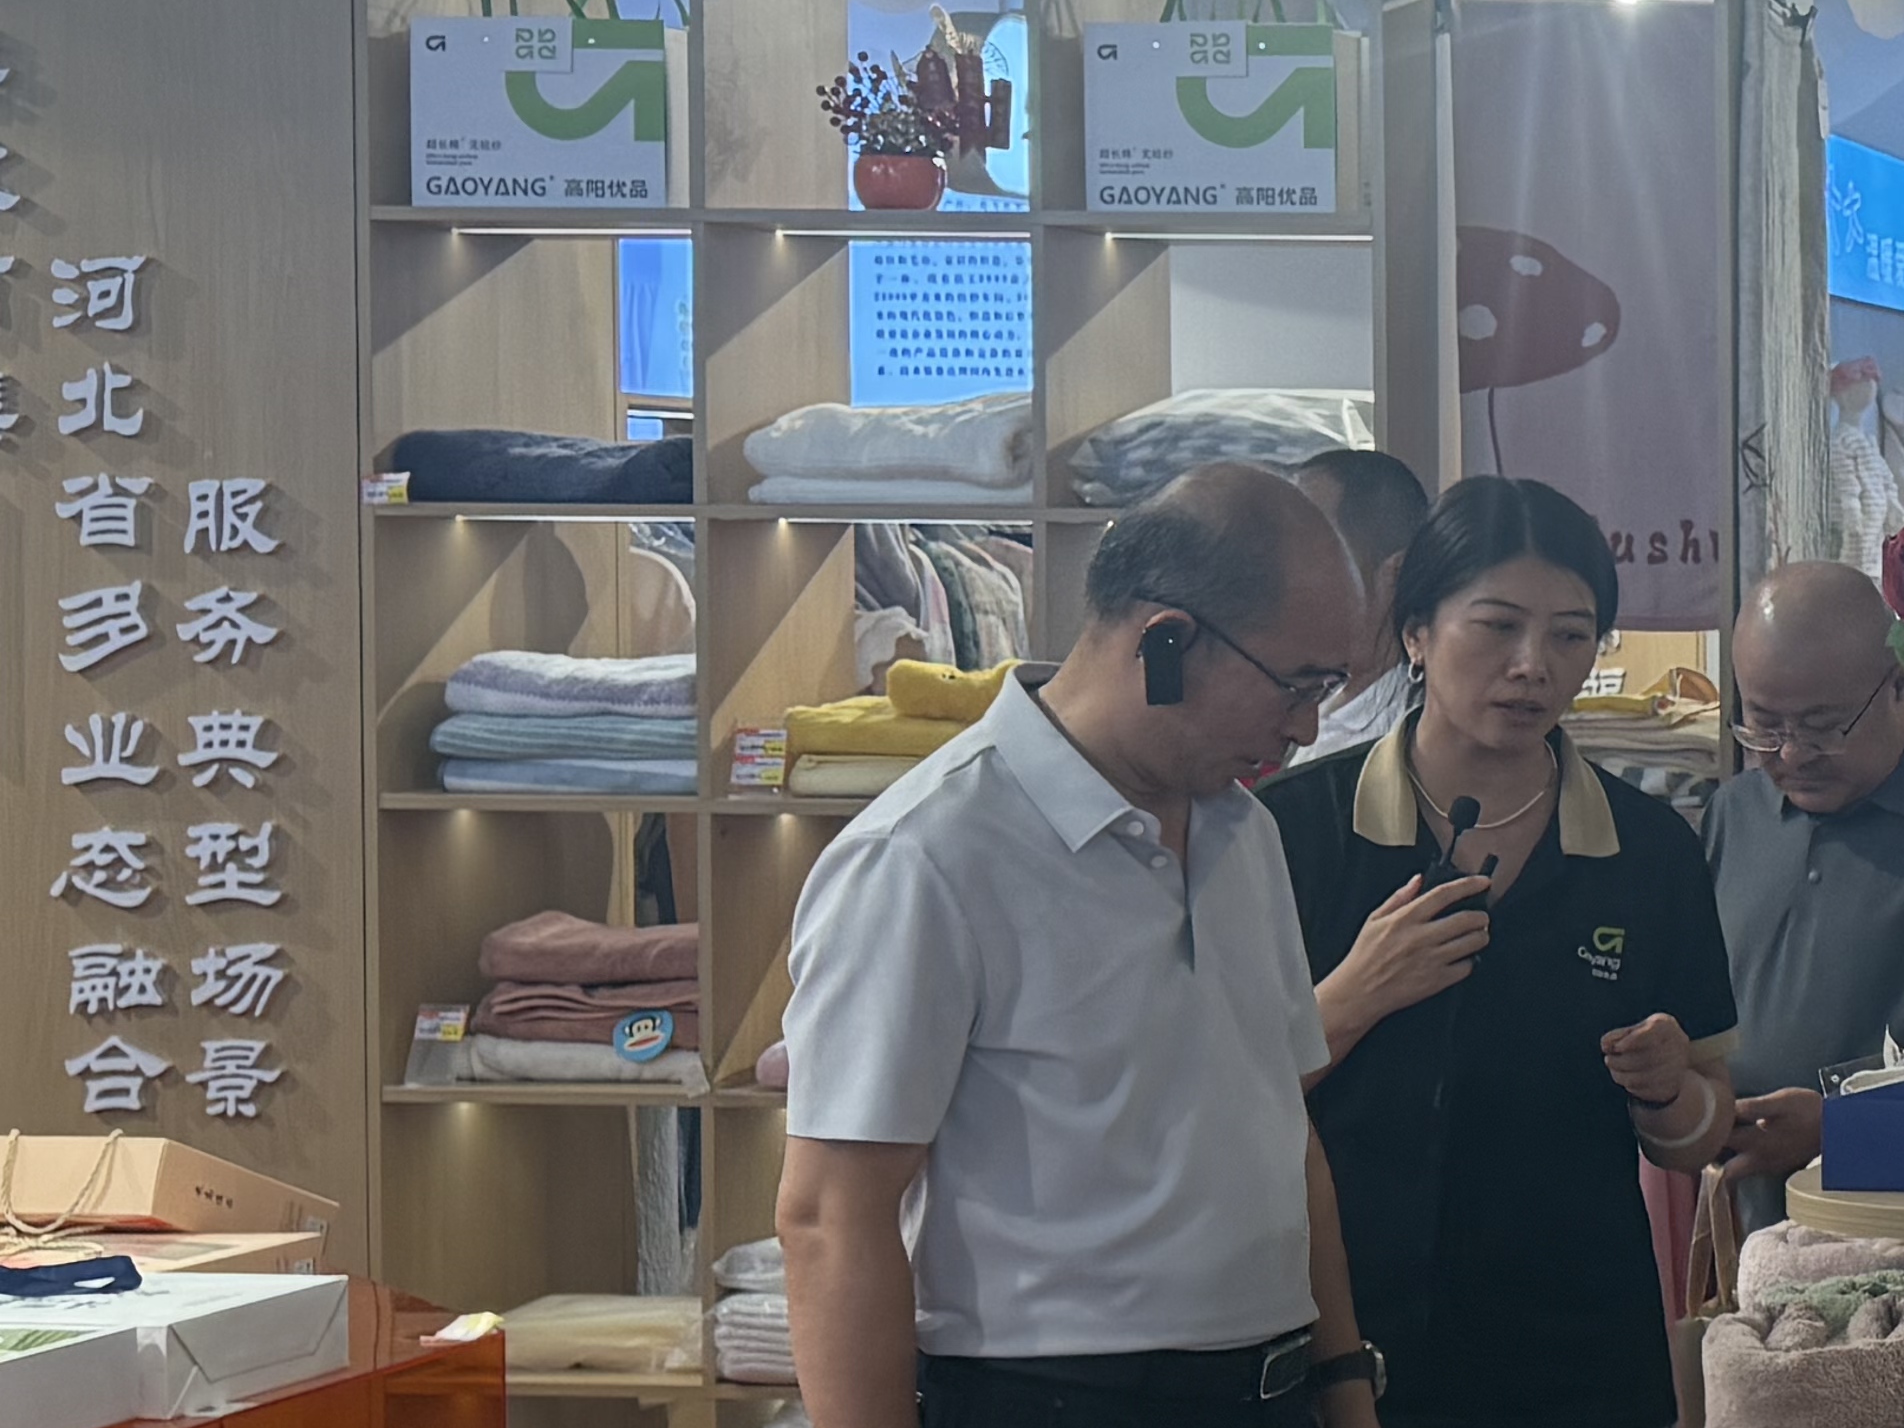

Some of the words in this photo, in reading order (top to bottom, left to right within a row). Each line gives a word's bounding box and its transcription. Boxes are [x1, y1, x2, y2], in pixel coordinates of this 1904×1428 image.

[425, 175, 547, 197] GAOYANG
[564, 178, 649, 199] 高阳优品
[1099, 185, 1218, 205] GAOYANG
[1235, 186, 1318, 206] 高阳优品
[50, 254, 173, 1113] 河北省多业态融合
[175, 476, 284, 1119] 服务典型场景
